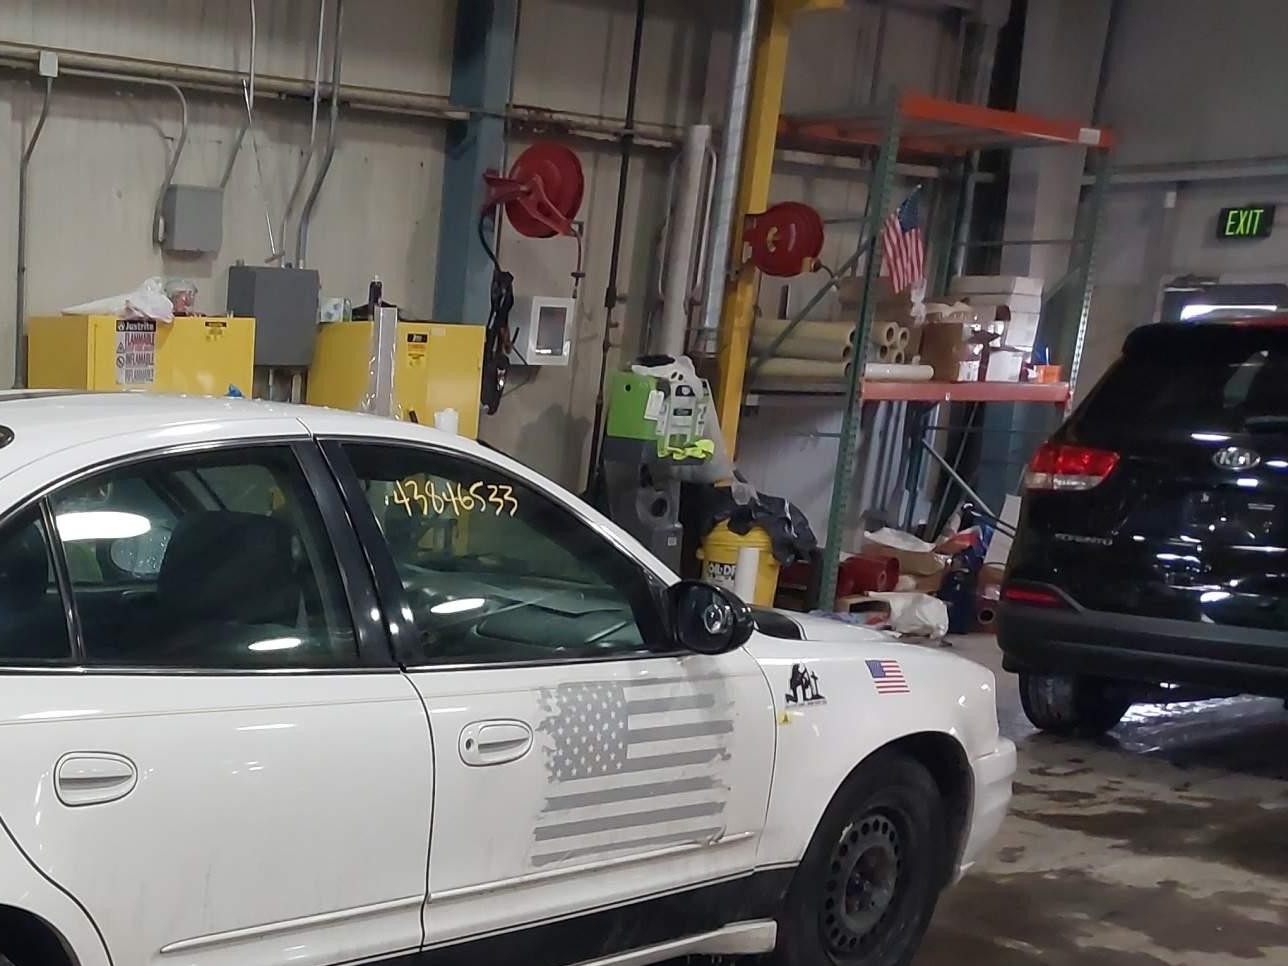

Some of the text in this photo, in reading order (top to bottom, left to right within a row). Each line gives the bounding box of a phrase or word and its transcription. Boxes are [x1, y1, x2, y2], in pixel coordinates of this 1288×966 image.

[1225, 210, 1264, 235] EXIT
[126, 322, 155, 331] Justrite
[1219, 450, 1251, 465] KIA
[393, 480, 518, 517] 43846533
